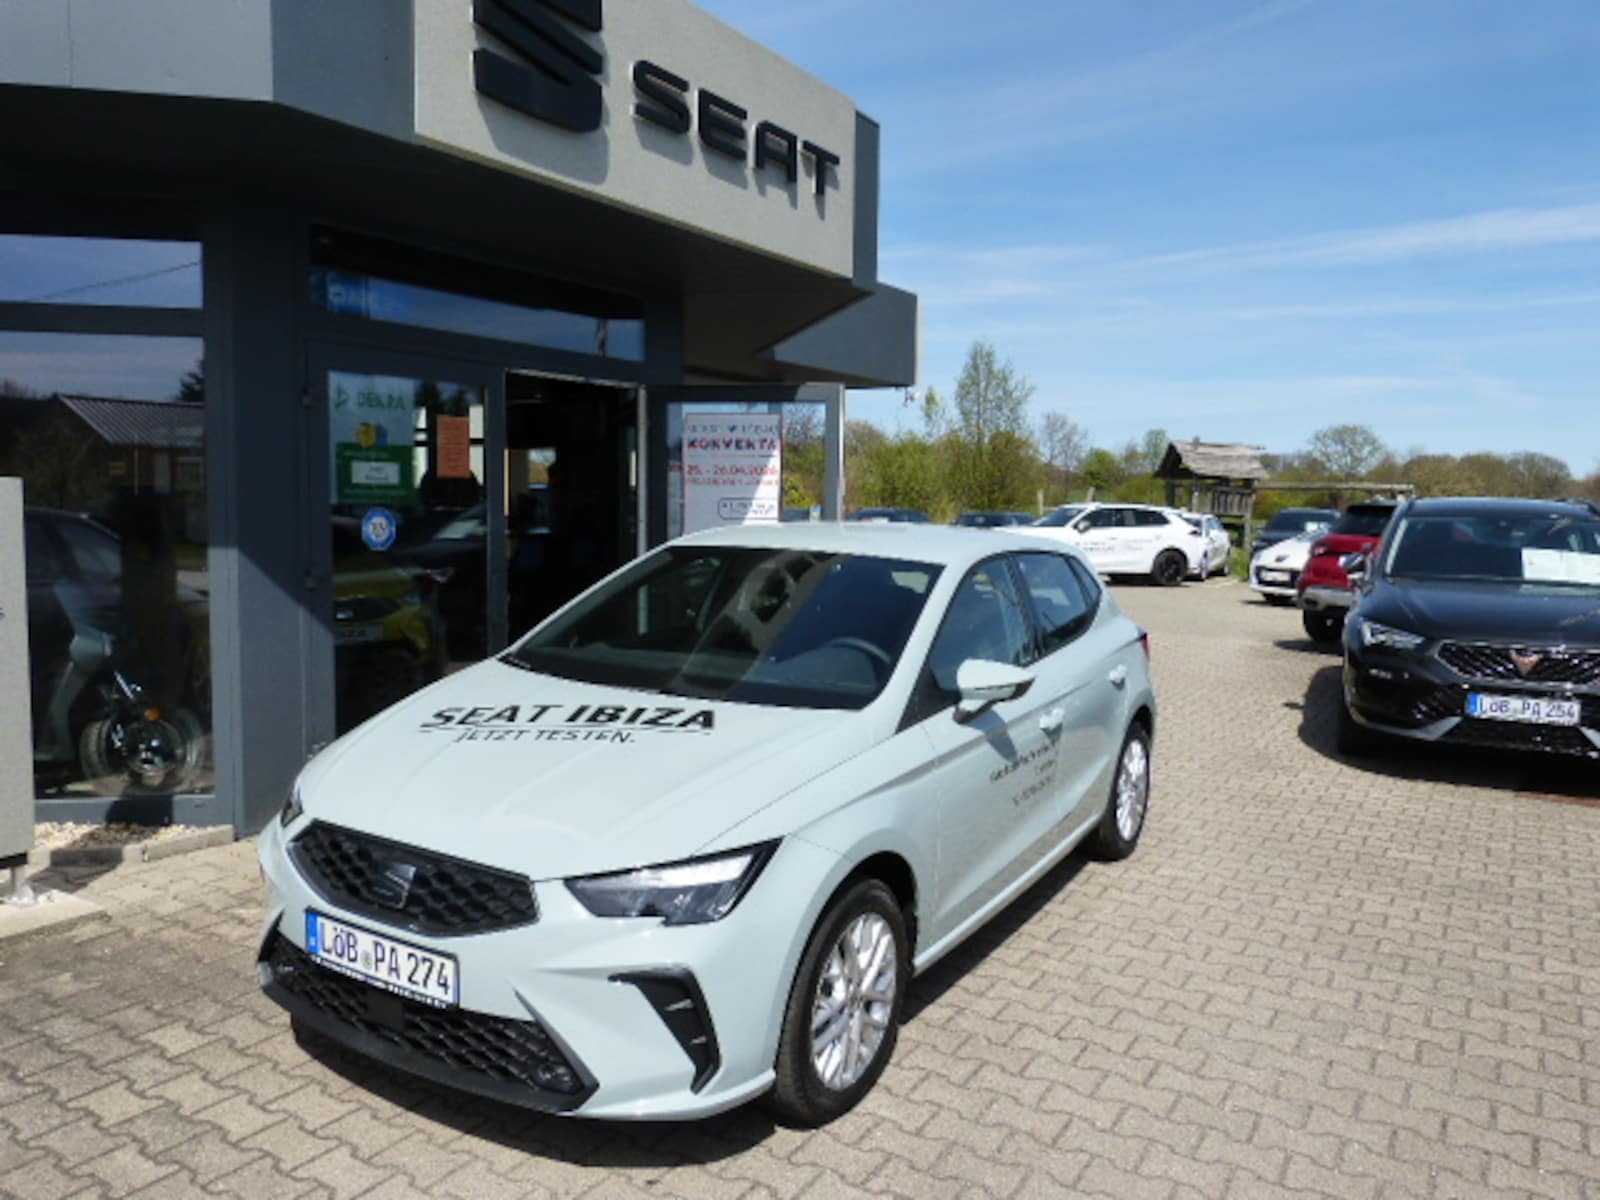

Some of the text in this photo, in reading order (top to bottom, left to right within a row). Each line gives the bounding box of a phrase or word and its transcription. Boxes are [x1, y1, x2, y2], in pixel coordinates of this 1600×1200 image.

[632, 59, 840, 196] SEAT
[420, 705, 715, 729] SEAT IBIZA
[453, 730, 636, 744] JETZT TESTEN.
[373, 940, 401, 980] PA
[407, 952, 451, 996] 274
